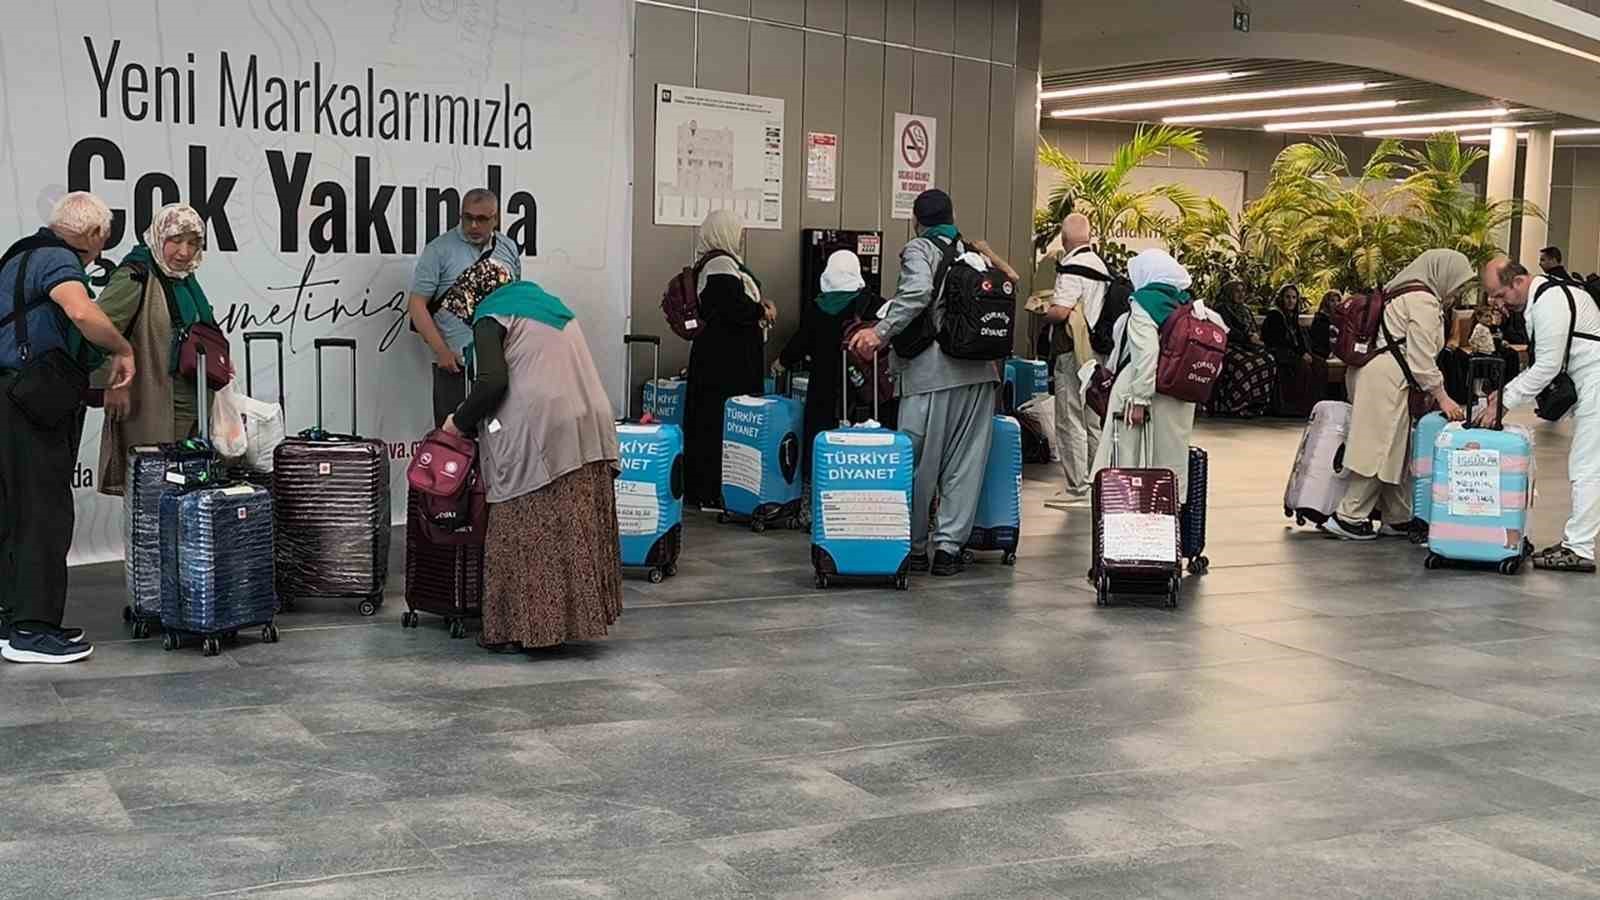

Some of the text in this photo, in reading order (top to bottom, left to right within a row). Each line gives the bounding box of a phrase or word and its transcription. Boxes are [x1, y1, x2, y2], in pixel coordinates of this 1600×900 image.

[83, 36, 532, 150] Yeni Markalarımızla
[619, 440, 658, 455] KİYE
[823, 450, 901, 465] TÜRKİYE
[828, 466, 897, 480] DİYANET
